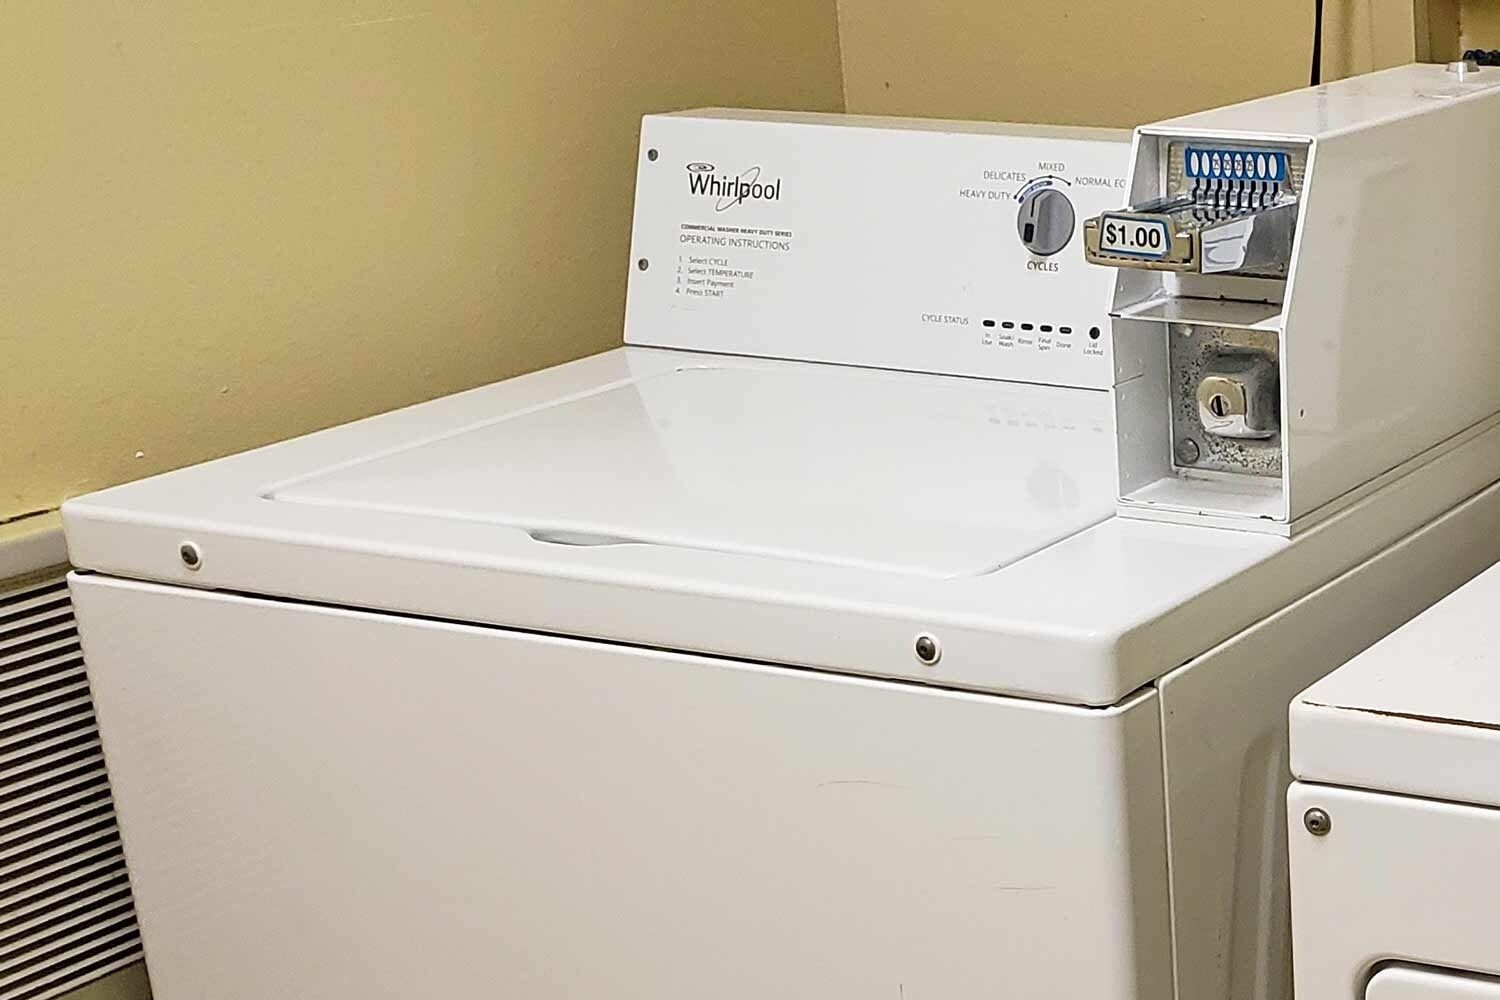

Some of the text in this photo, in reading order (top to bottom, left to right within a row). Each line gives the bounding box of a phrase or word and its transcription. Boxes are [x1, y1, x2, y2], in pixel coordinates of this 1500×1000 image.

[1038, 162, 1065, 172] MIXED
[983, 170, 1026, 181] DELICATES
[1075, 177, 1112, 188] NORMAL
[689, 172, 781, 205] Whirlpool
[959, 189, 1011, 200] HEAVY DUTY
[681, 223, 715, 232] COMMERCIAL
[774, 230, 792, 238] SERIES
[1106, 222, 1160, 249] $1.00
[680, 233, 790, 251] OPERATING INSTRUCTIONS
[688, 256, 707, 265] Select
[708, 258, 728, 267] CYCLE
[1027, 261, 1059, 272] CYCLES
[688, 267, 706, 275] Select
[708, 268, 754, 280] TEMPERATURE
[704, 289, 723, 297] START
[921, 314, 969, 326] CYCLE STATUS
